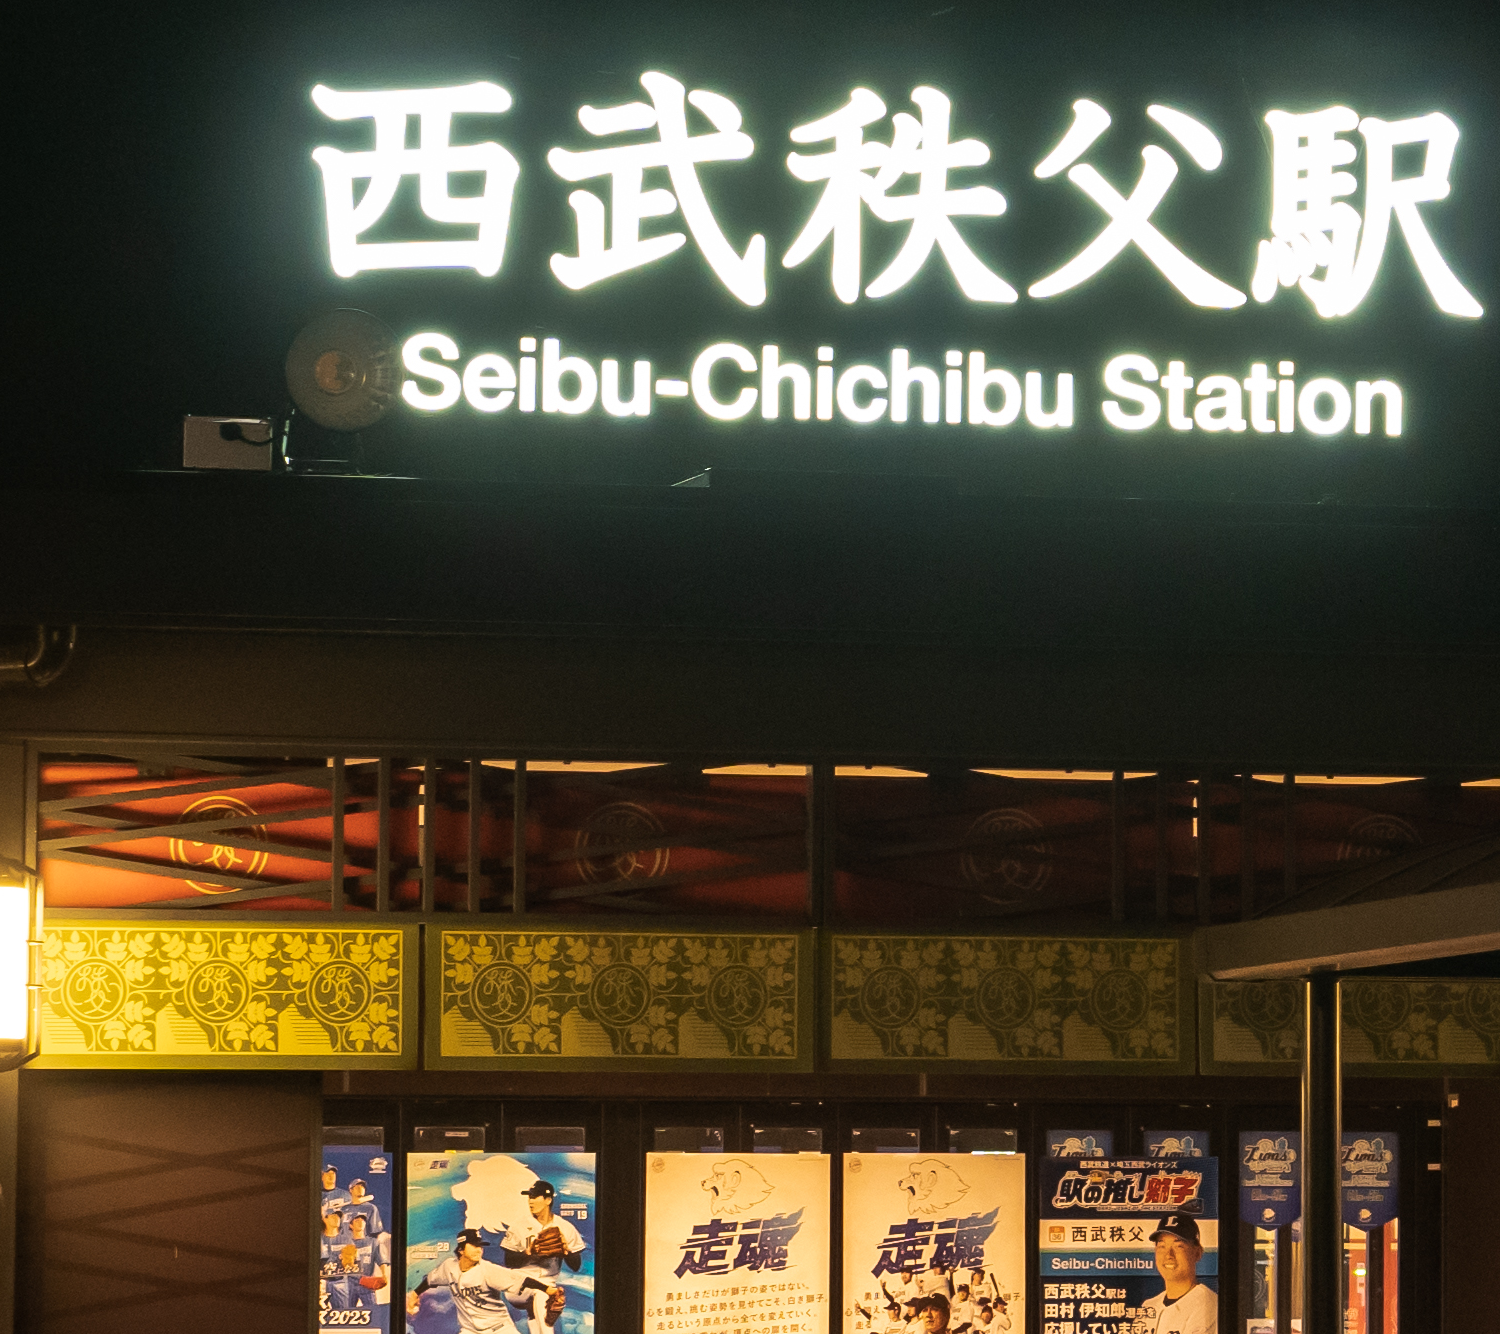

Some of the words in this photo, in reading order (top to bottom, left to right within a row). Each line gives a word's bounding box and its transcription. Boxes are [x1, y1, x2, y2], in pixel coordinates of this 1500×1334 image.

[311, 71, 1484, 320] 西武秩父駅
[400, 330, 1075, 429] Seibu-Chichibu
[1100, 353, 1405, 437] Station
[1244, 1146, 1288, 1164] Lions
[577, 1210, 588, 1220] 19
[673, 1206, 806, 1279] 走魂
[871, 1206, 1001, 1279] 走魂
[1071, 1226, 1144, 1243] 西武秩父
[1051, 1257, 1154, 1270] Seibu-Chichibu
[1043, 1283, 1127, 1299] 西武秩父駅は
[1043, 1302, 1075, 1319] 田村
